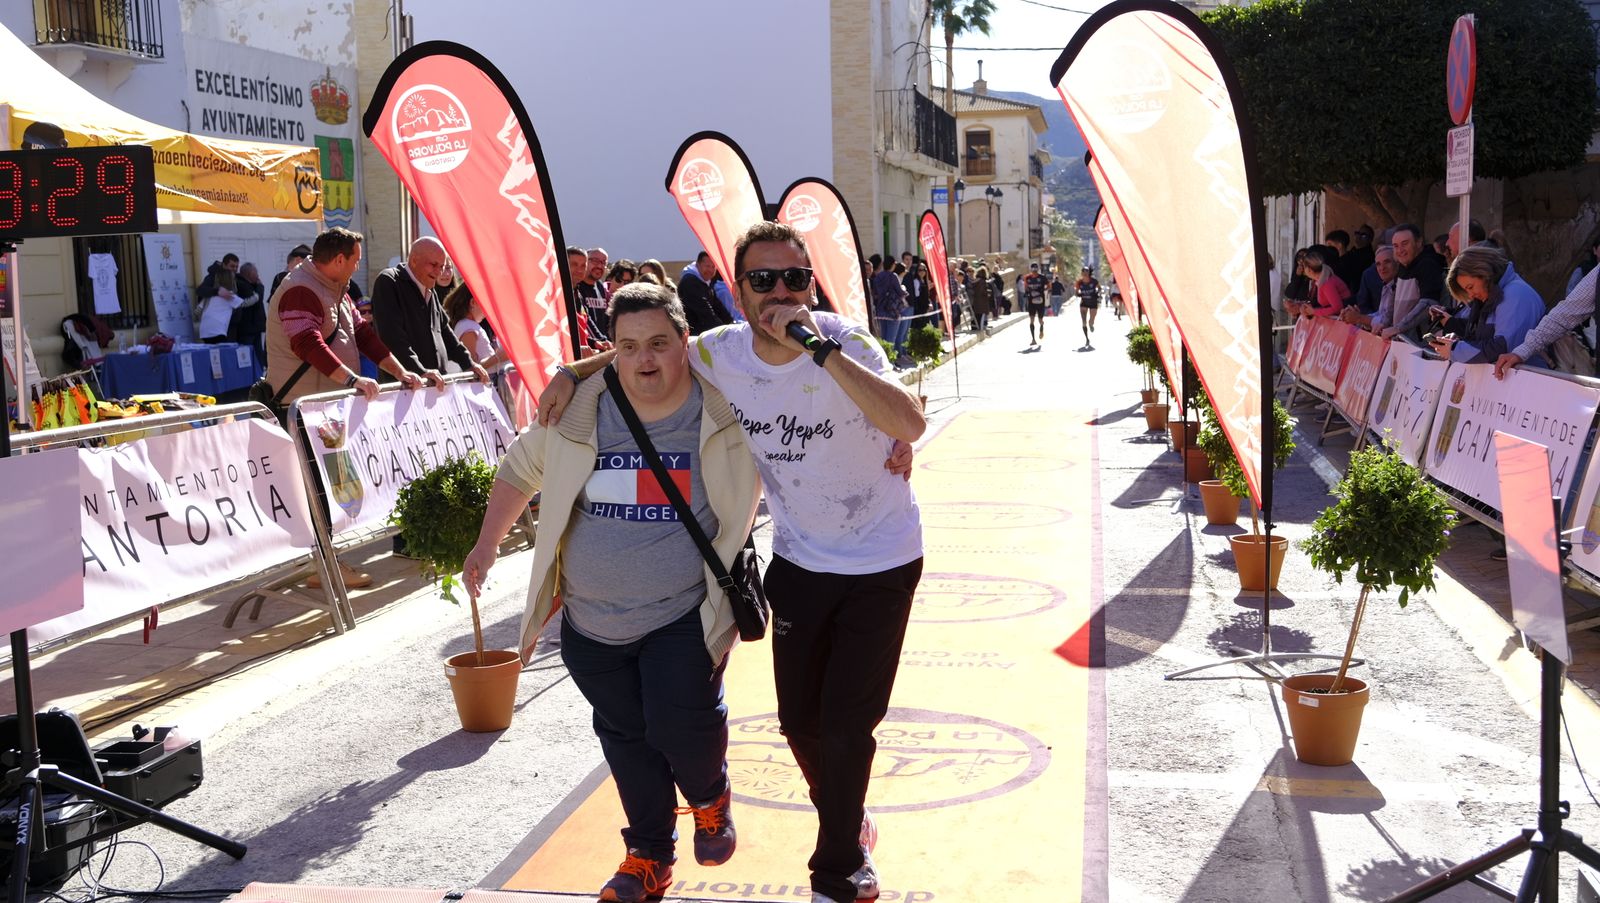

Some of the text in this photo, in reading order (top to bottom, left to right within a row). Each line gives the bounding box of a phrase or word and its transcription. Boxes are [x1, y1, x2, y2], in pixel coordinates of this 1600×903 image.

[195, 68, 303, 109] EXCELENTÍSIMO
[202, 107, 305, 142] AYUNTAMIENTO
[359, 408, 498, 447] AYUNTAMIENTO DE
[776, 414, 836, 449] Yepes
[1559, 422, 1578, 446] DE
[596, 455, 680, 469] TOMY
[84, 455, 273, 516] NTAMIENTO DE
[81, 484, 292, 577] ANTORIA
[16, 802, 31, 846] VONYX
